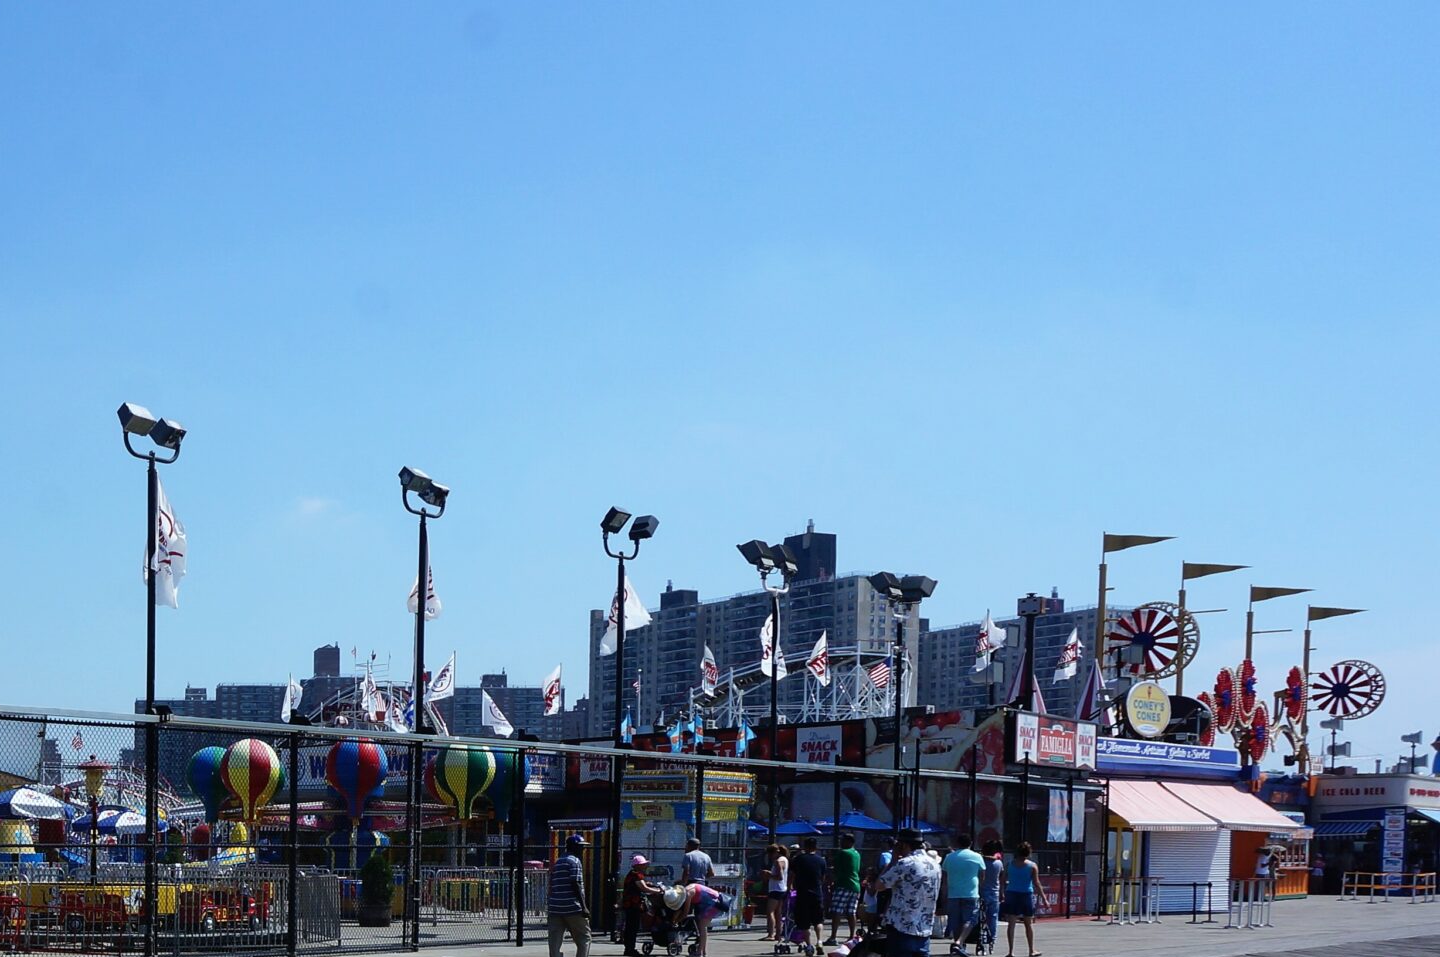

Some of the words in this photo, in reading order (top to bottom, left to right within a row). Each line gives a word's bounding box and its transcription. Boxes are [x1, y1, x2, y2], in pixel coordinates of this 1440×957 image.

[1133, 699, 1165, 711] CONEY'S
[1136, 712, 1161, 722] CONES
[801, 740, 838, 752] SNACK
[1040, 735, 1073, 754] FAMIGLIA
[808, 752, 831, 763] BAR
[1322, 788, 1336, 796] ICE
